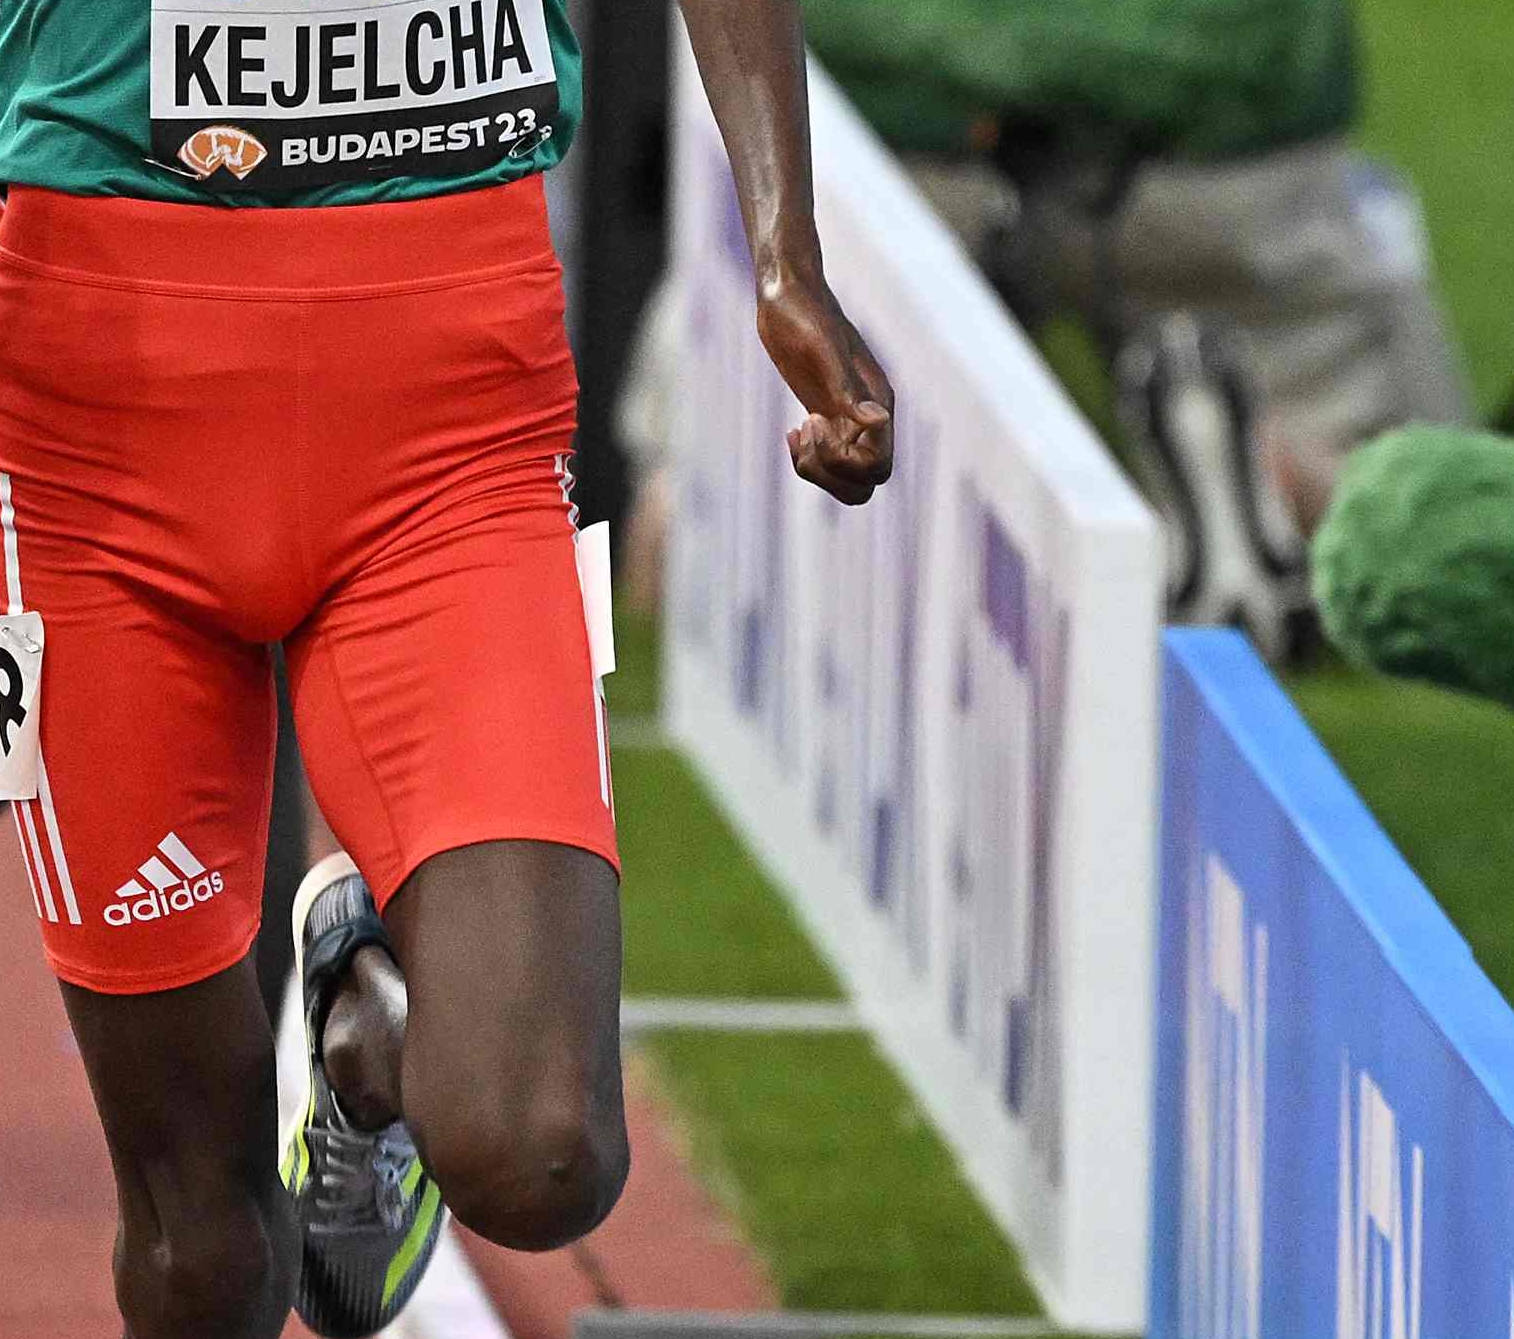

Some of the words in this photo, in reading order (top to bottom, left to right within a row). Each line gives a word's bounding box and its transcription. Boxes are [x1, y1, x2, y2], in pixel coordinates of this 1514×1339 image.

[281, 116, 491, 166] BUDAPEST
[496, 108, 537, 142] 23
[103, 868, 225, 926] adidas
